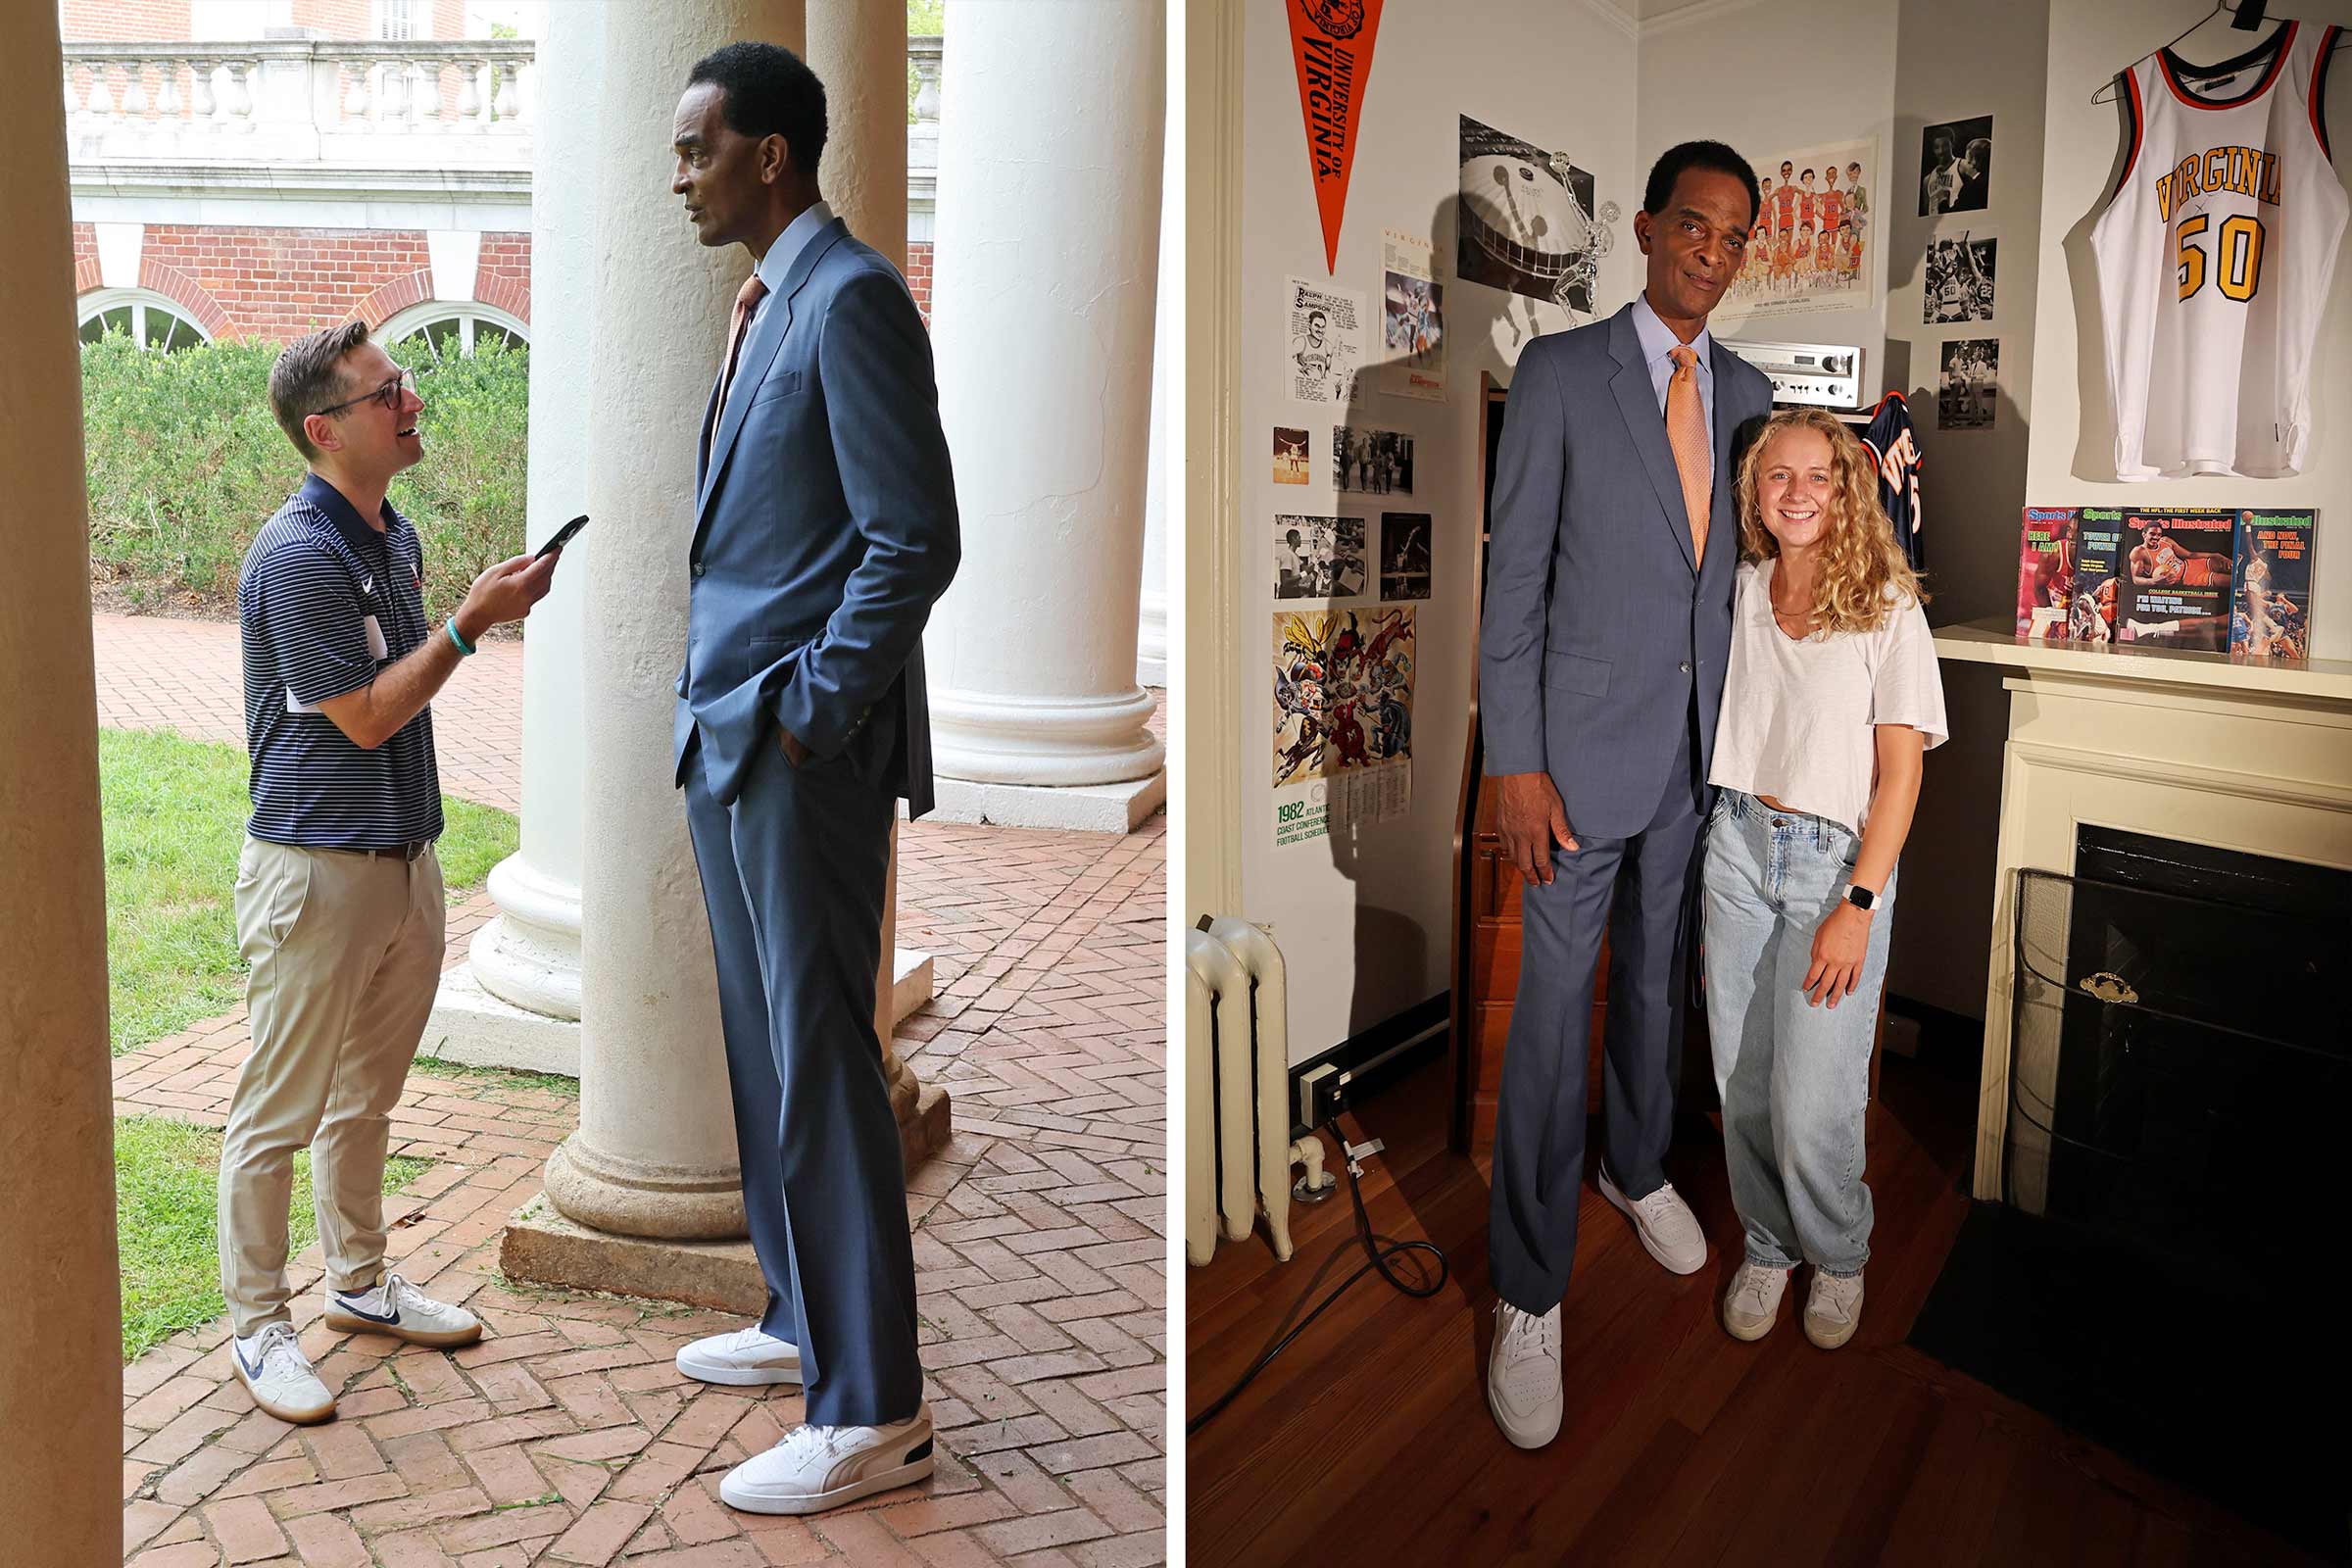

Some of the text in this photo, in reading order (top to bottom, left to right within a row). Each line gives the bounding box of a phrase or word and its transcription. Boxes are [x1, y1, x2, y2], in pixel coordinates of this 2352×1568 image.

[1301, 35, 1333, 178] VIRGINIA
[1332, 47, 1354, 178] UNIVERSITY OF
[2177, 213, 2266, 304] 50
[2029, 509, 2066, 521] Sports
[2083, 508, 2123, 520] Sports
[2129, 516, 2232, 530] Spts Illustrated
[2028, 531, 2050, 541] HERE
[2082, 531, 2111, 541] TOWER
[2257, 530, 2299, 541] AND NOW,
[2032, 542, 2036, 552] I
[2086, 541, 2117, 551] POWER
[2263, 540, 2306, 551] THE FINAL
[2278, 550, 2300, 560] FOUR
[1278, 801, 1304, 823] 1982
[1277, 823, 1295, 836] COAST
[1276, 833, 1303, 847] FOOTBALL
